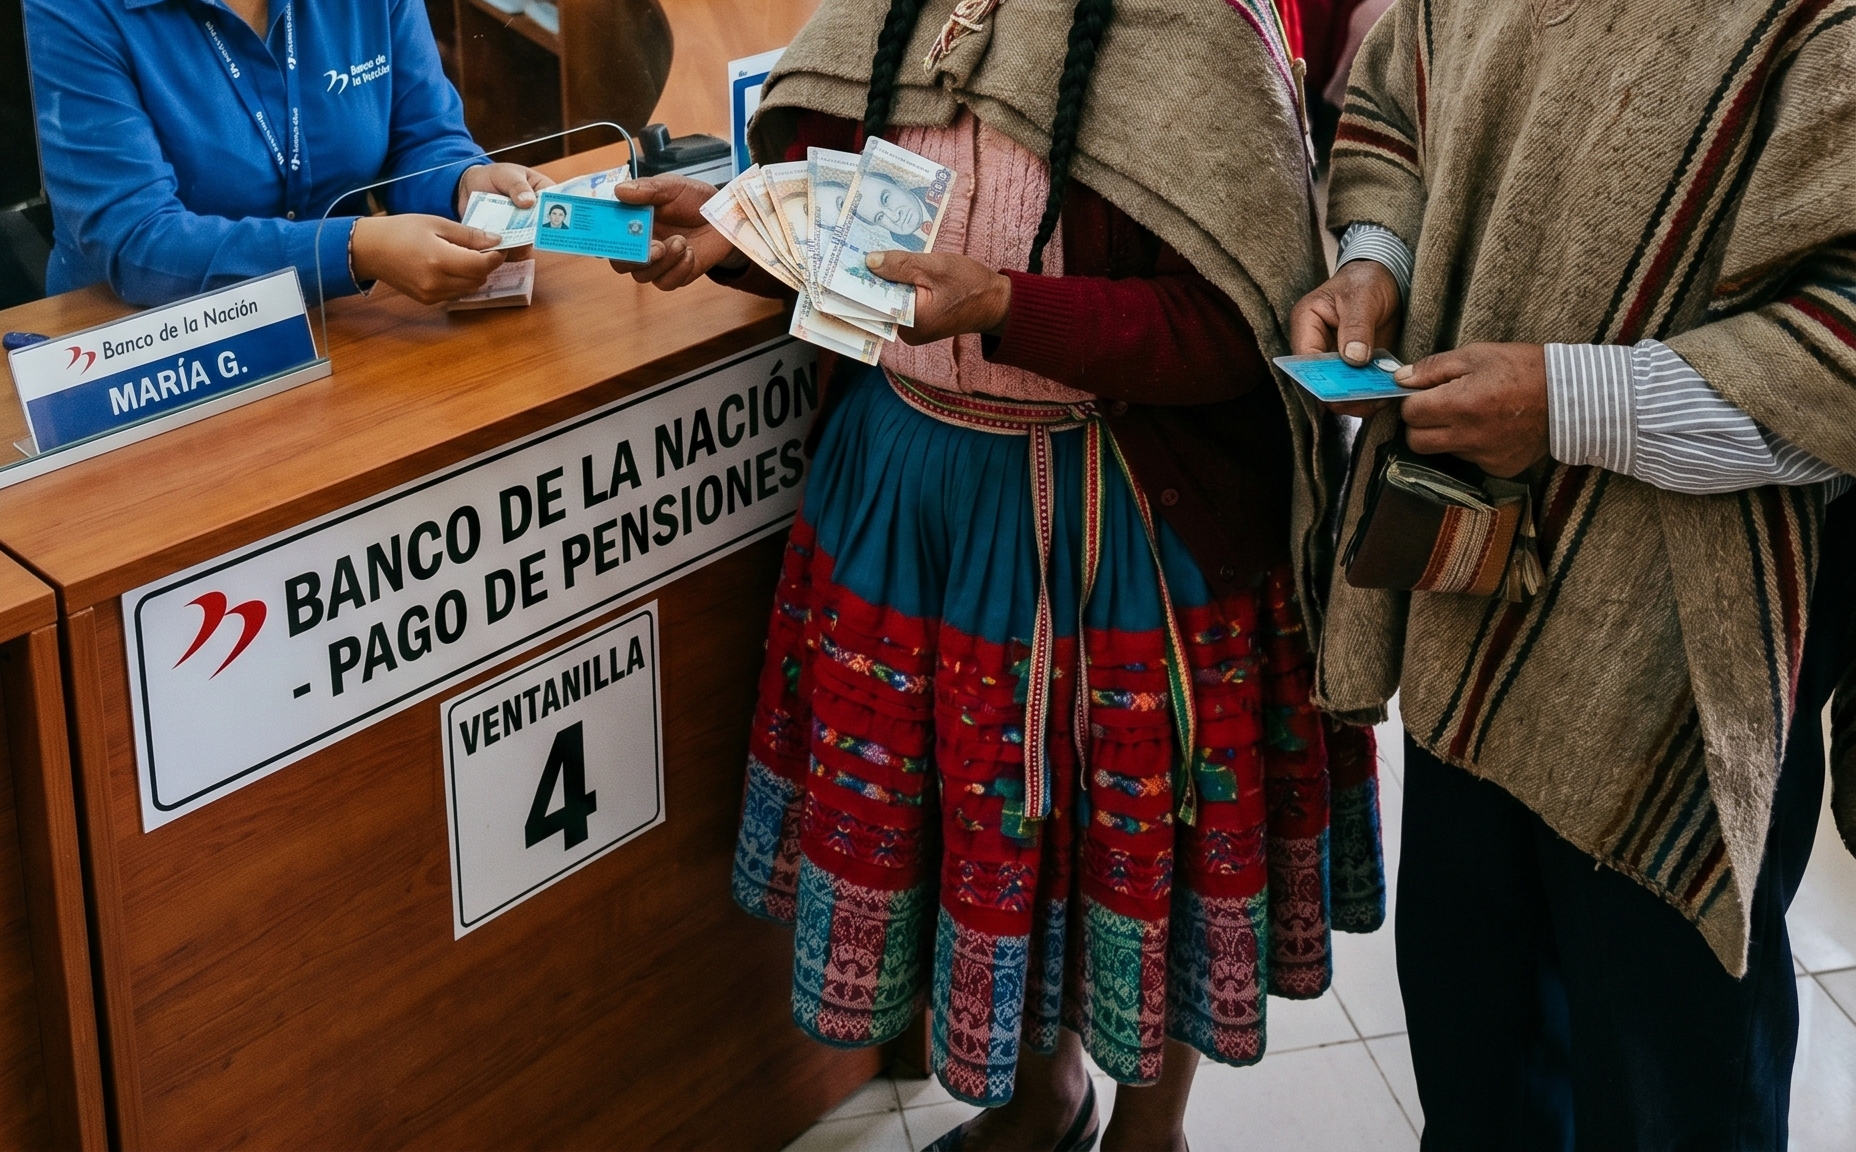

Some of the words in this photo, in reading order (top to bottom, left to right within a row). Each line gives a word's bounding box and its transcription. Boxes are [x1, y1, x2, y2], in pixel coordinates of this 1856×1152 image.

[375, 54, 386, 65] de
[103, 333, 154, 360] Banco
[159, 322, 178, 343] de
[184, 316, 199, 335] la
[204, 298, 258, 328] Nación
[109, 357, 211, 416] MARÍA
[217, 350, 248, 379] G.
[284, 504, 481, 639] BANCO
[499, 466, 567, 540] DE
[581, 440, 642, 511] LA
[655, 358, 818, 480] NACIÓN
[329, 587, 468, 698] PAGO
[485, 557, 549, 627] DE
[563, 438, 803, 589] PENSIONES
[459, 636, 646, 756] VENTANILLA
[524, 720, 597, 852] 4
